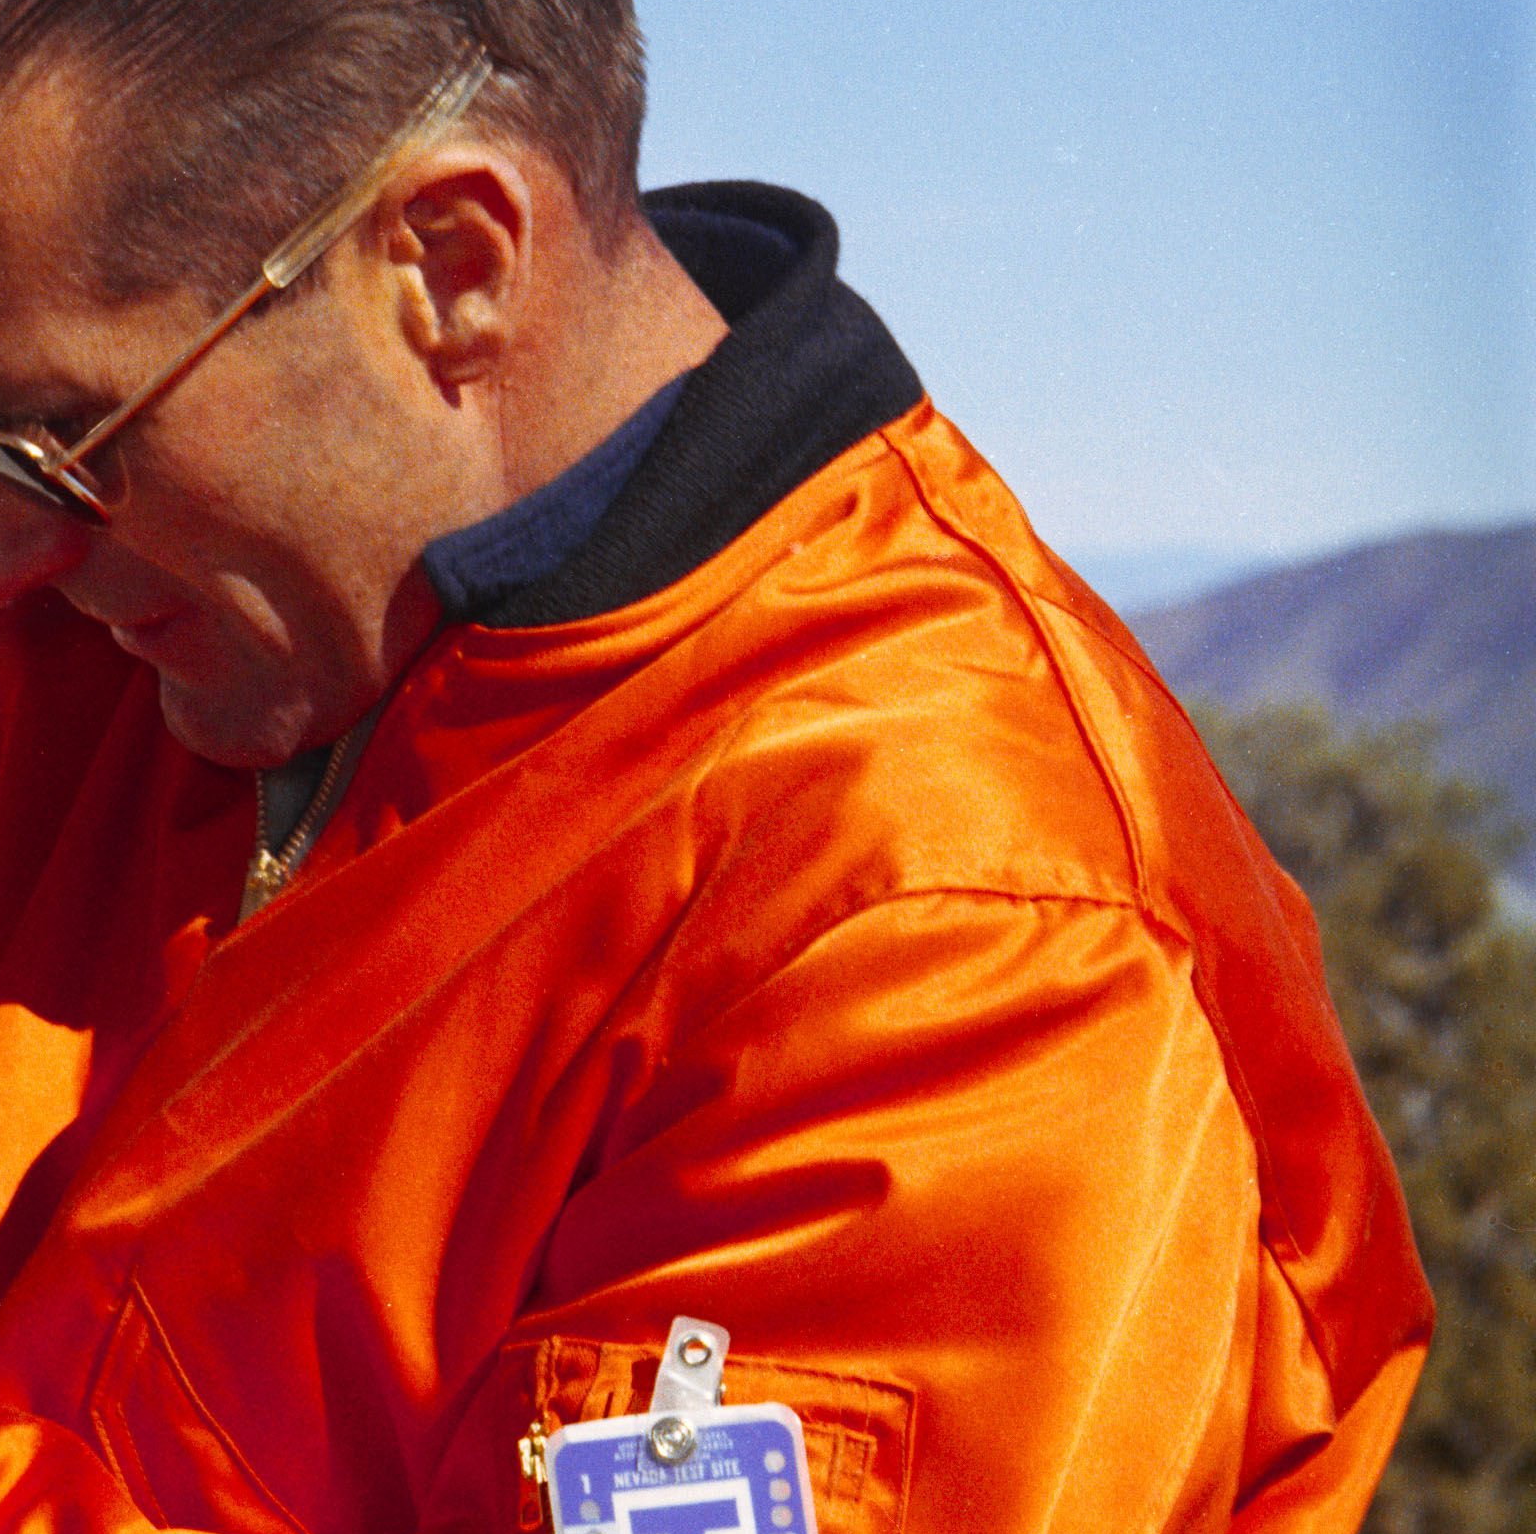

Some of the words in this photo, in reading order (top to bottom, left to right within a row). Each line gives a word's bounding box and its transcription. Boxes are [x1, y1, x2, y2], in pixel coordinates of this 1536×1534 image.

[580, 1473, 592, 1495] 1
[614, 1467, 667, 1487] NEVADA
[673, 1462, 705, 1482] TEST
[712, 1457, 741, 1479] SITE
